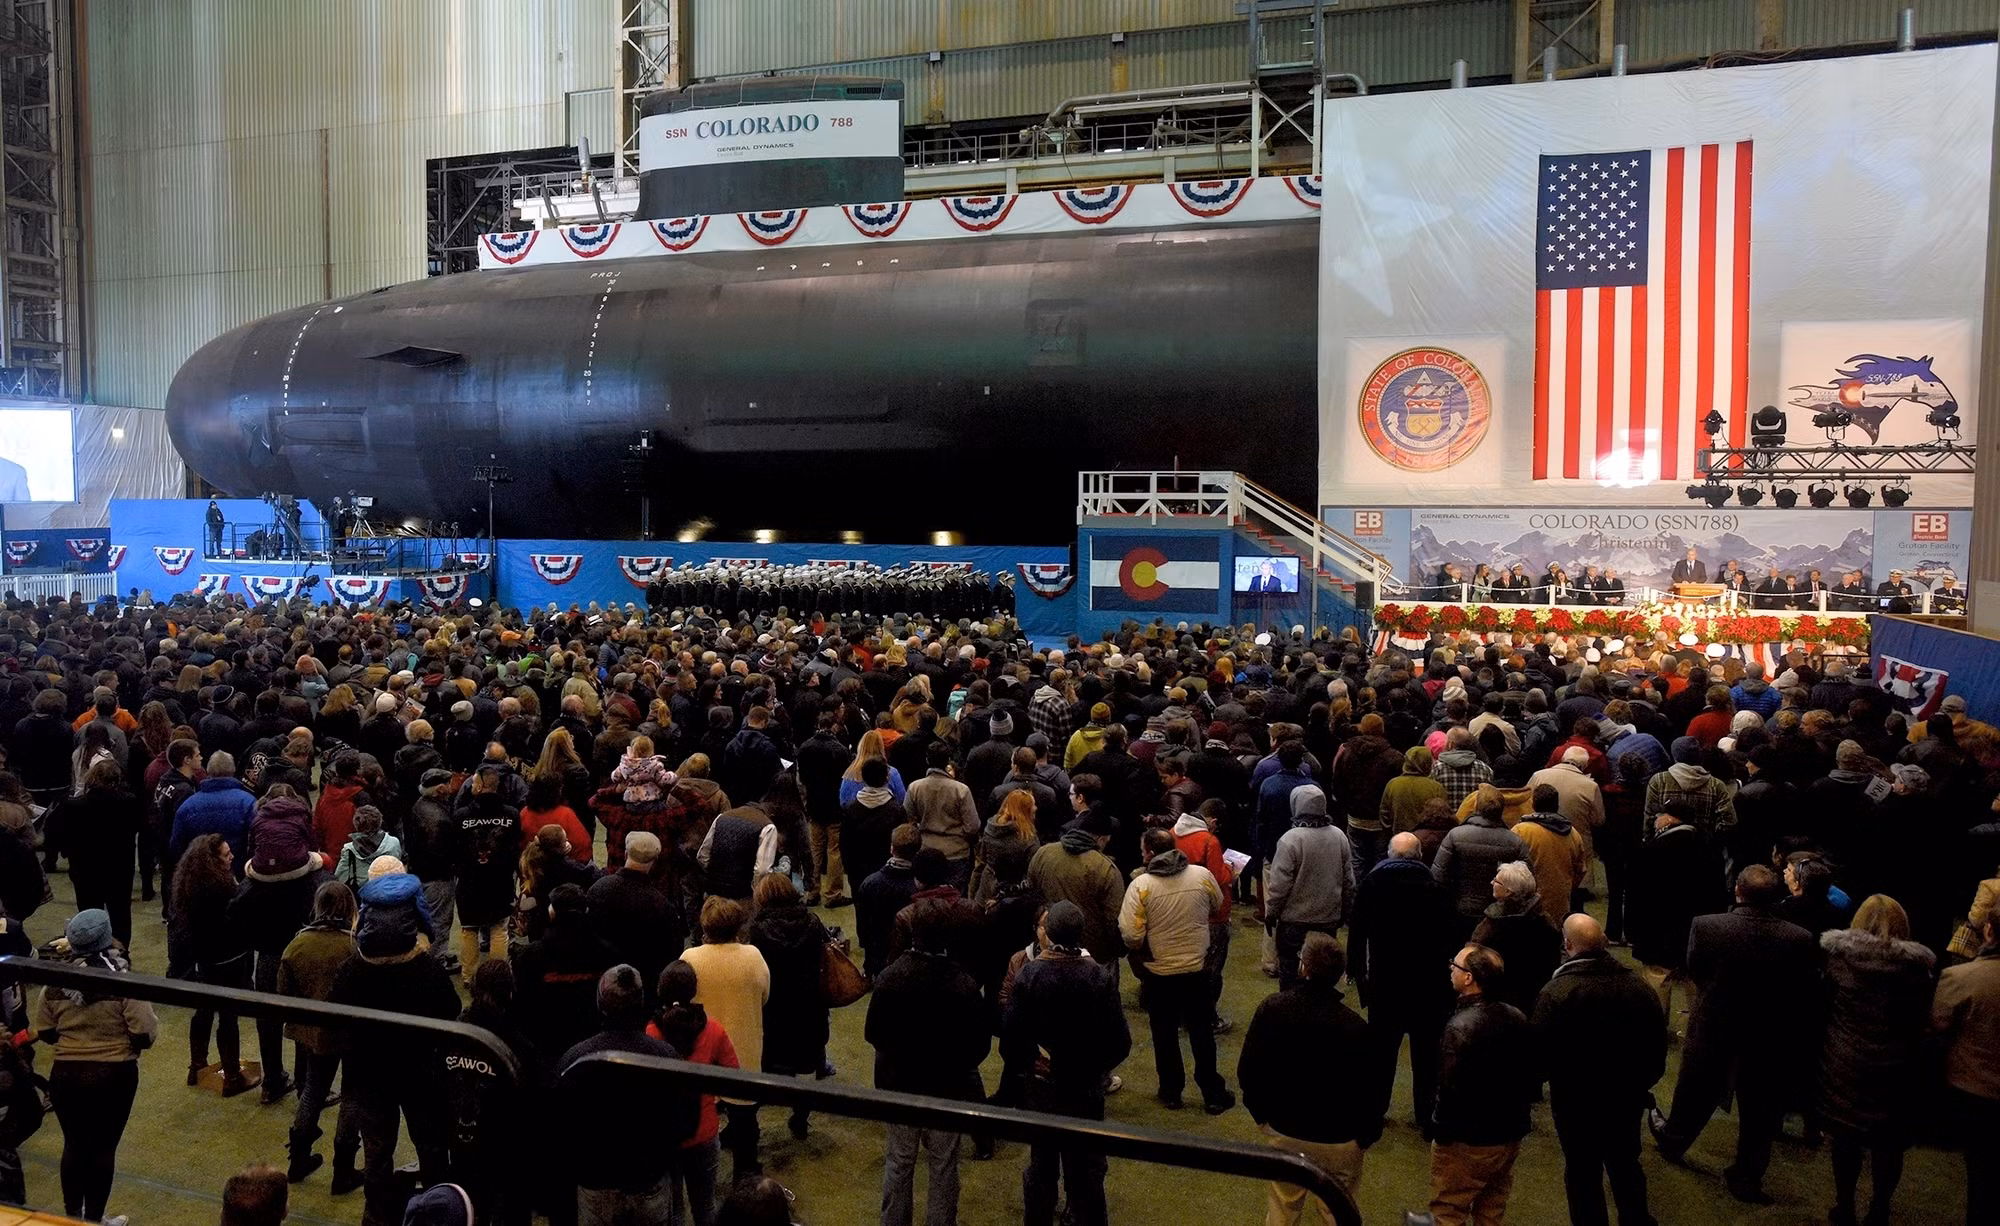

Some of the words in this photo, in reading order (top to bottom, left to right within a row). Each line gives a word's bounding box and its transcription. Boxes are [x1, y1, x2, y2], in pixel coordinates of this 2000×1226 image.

[665, 128, 688, 139] SSN
[696, 113, 819, 139] COLORADO
[830, 117, 853, 128] 788
[717, 145, 751, 153] GENERAL
[753, 142, 794, 150] DYNAMICS
[1364, 369, 1391, 412] STATE
[1395, 354, 1416, 370] OF
[1424, 353, 1486, 412] COLORADO
[1355, 512, 1382, 528] EB
[1529, 514, 1649, 530] COLORADO
[1655, 514, 1739, 532] (SSN788)
[1914, 514, 1947, 533] EB
[1586, 537, 1679, 552] Christening
[1898, 541, 1928, 549] Groton
[1930, 541, 1960, 550] Facility
[462, 818, 513, 830] SEAWOLF
[445, 1055, 497, 1077] SEAWOL
